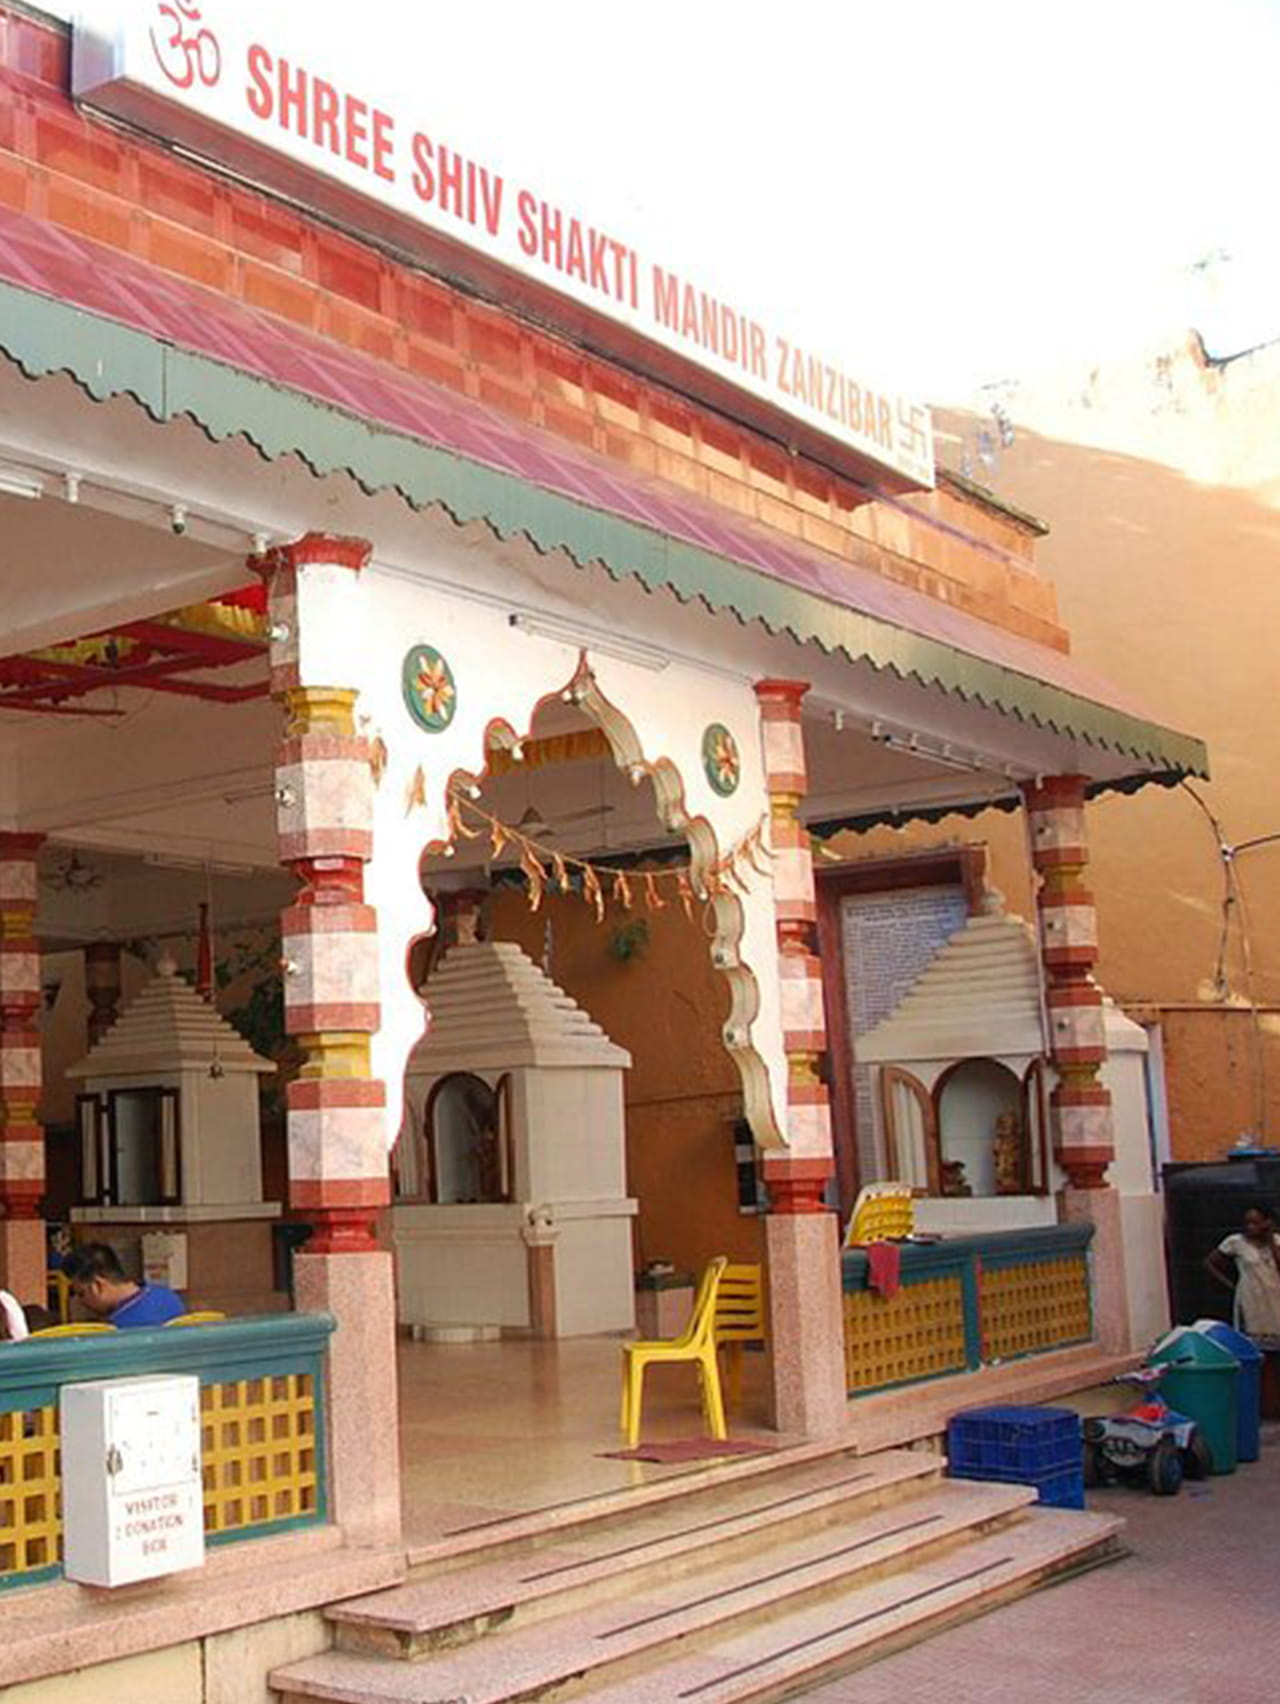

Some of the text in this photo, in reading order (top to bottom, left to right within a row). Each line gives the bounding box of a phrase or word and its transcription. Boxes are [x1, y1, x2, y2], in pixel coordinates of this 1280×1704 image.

[245, 43, 893, 452] SHREE SHIV SHAKTI MANDIR ZANZIBAR
